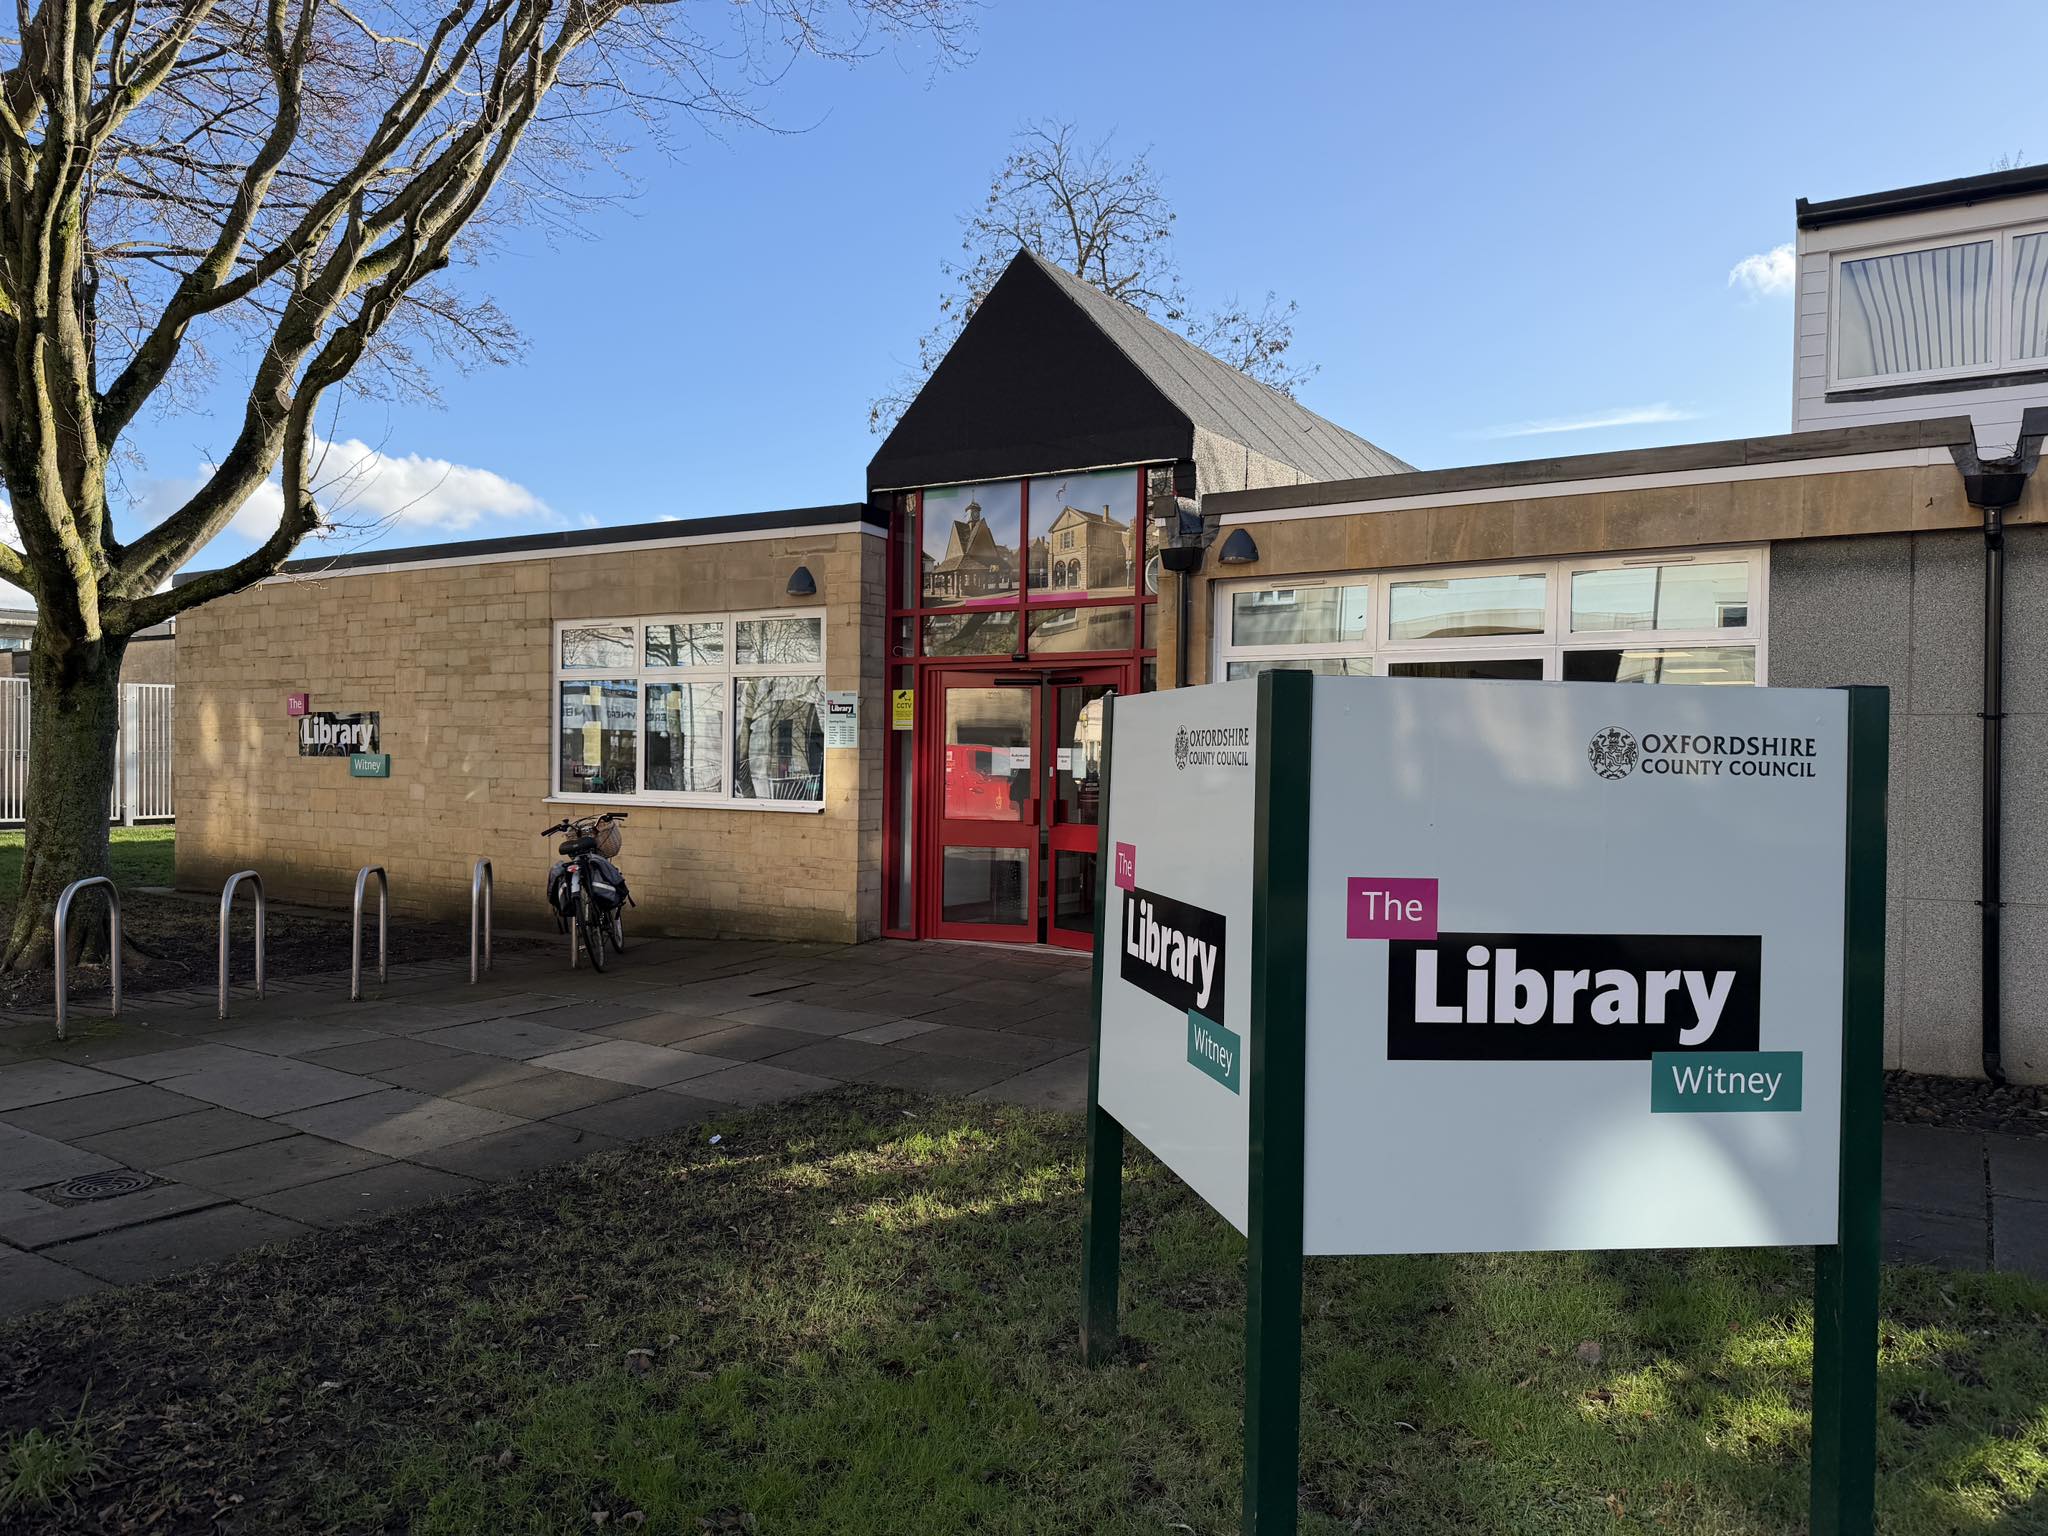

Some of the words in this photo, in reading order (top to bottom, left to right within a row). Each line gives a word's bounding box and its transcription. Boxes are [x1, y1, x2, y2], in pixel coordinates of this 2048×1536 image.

[288, 698, 303, 709] The
[831, 705, 853, 713] Library
[303, 716, 374, 752] Library
[1189, 727, 1249, 747] OXFORDSHIRE
[1641, 733, 1817, 757] OXFORDSHIRE
[354, 758, 382, 773] Witney
[1188, 751, 1215, 765] COUNTY
[1216, 751, 1249, 766] COUNCIL
[1641, 758, 1723, 776] COUNTY
[1729, 760, 1817, 778] COUNCIL
[1118, 852, 1132, 878] The
[1362, 891, 1424, 921] The
[1126, 897, 1217, 1010] Library
[1414, 945, 1737, 1046] Library
[1193, 1023, 1233, 1077] Witney
[1671, 1065, 1783, 1102] Witney
